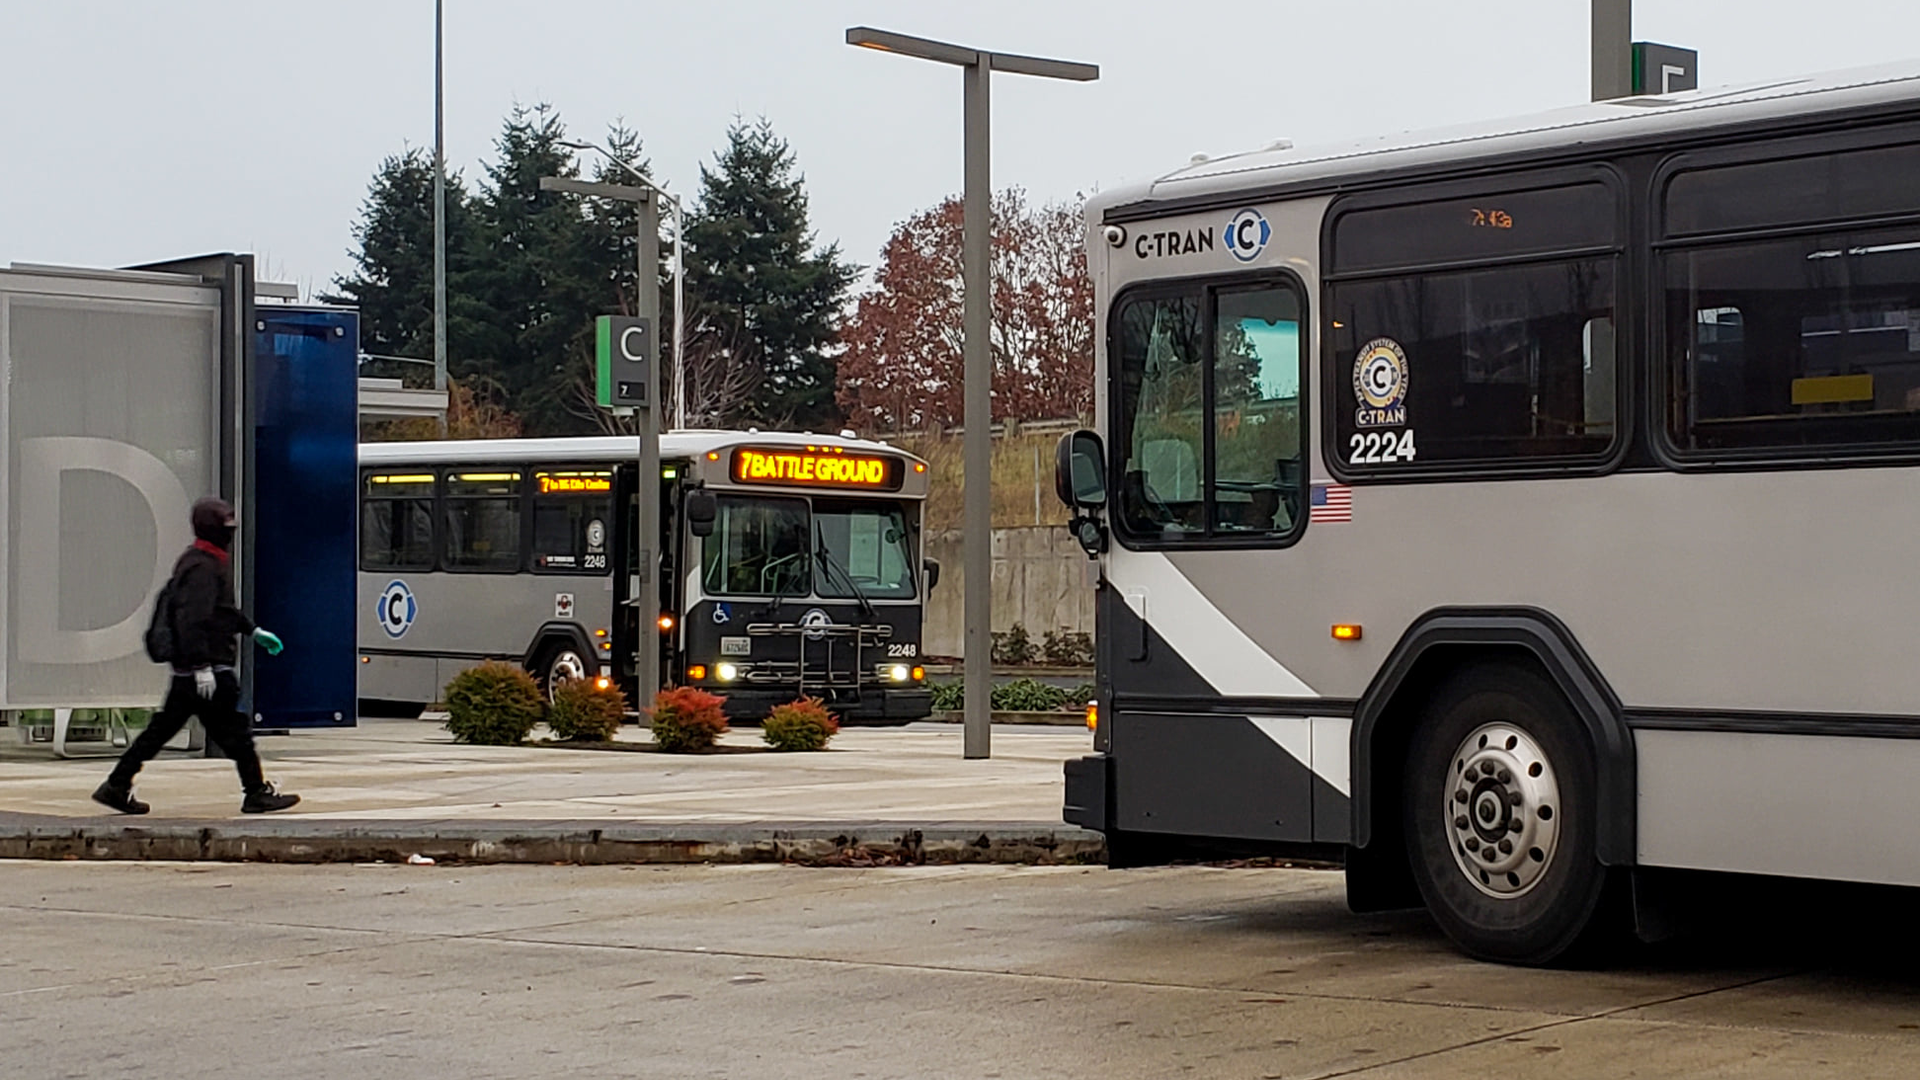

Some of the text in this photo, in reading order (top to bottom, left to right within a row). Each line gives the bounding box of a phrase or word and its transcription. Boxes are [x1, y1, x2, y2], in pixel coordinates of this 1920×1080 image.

[1135, 227, 1213, 259] C-TRAN
[620, 326, 643, 361] C
[620, 385, 628, 396] 7
[1358, 408, 1404, 425] C-TRAN
[1349, 429, 1416, 464] 2224
[741, 452, 884, 483] 7 BATTLE GROUND
[541, 477, 550, 493] 7
[17, 436, 193, 664] D
[584, 555, 606, 568] 2248
[887, 644, 916, 657] 2248
